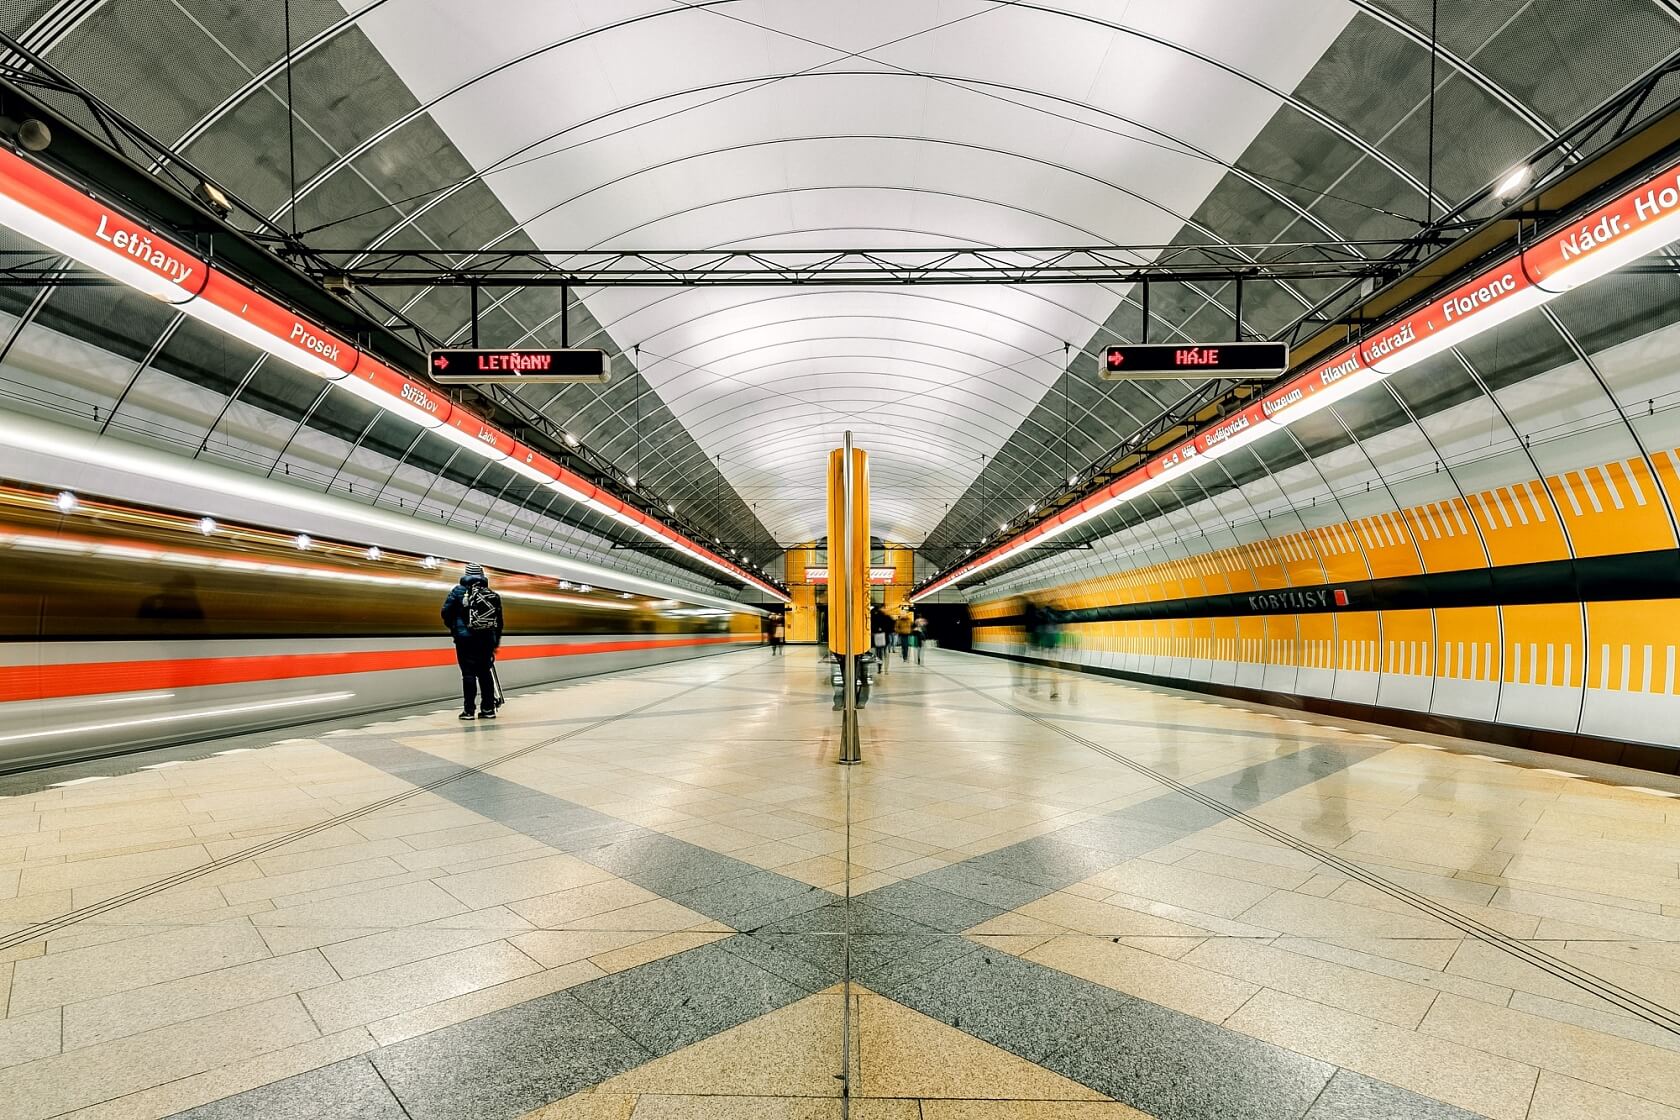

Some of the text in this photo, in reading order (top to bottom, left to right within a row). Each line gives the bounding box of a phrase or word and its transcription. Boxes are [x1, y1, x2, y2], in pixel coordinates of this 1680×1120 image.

[95, 214, 192, 283] Letňany
[1560, 214, 1630, 261] Nádr.
[1443, 274, 1516, 321] Florenc
[290, 322, 340, 361] Prosek
[1176, 348, 1218, 364] HÁJE
[1320, 322, 1416, 385] Hlavní nádraží
[478, 353, 550, 369] LETŇANY
[401, 383, 438, 412] Střížkov
[1262, 388, 1302, 416] Muzeum
[1249, 590, 1327, 610] KOBYLISY
